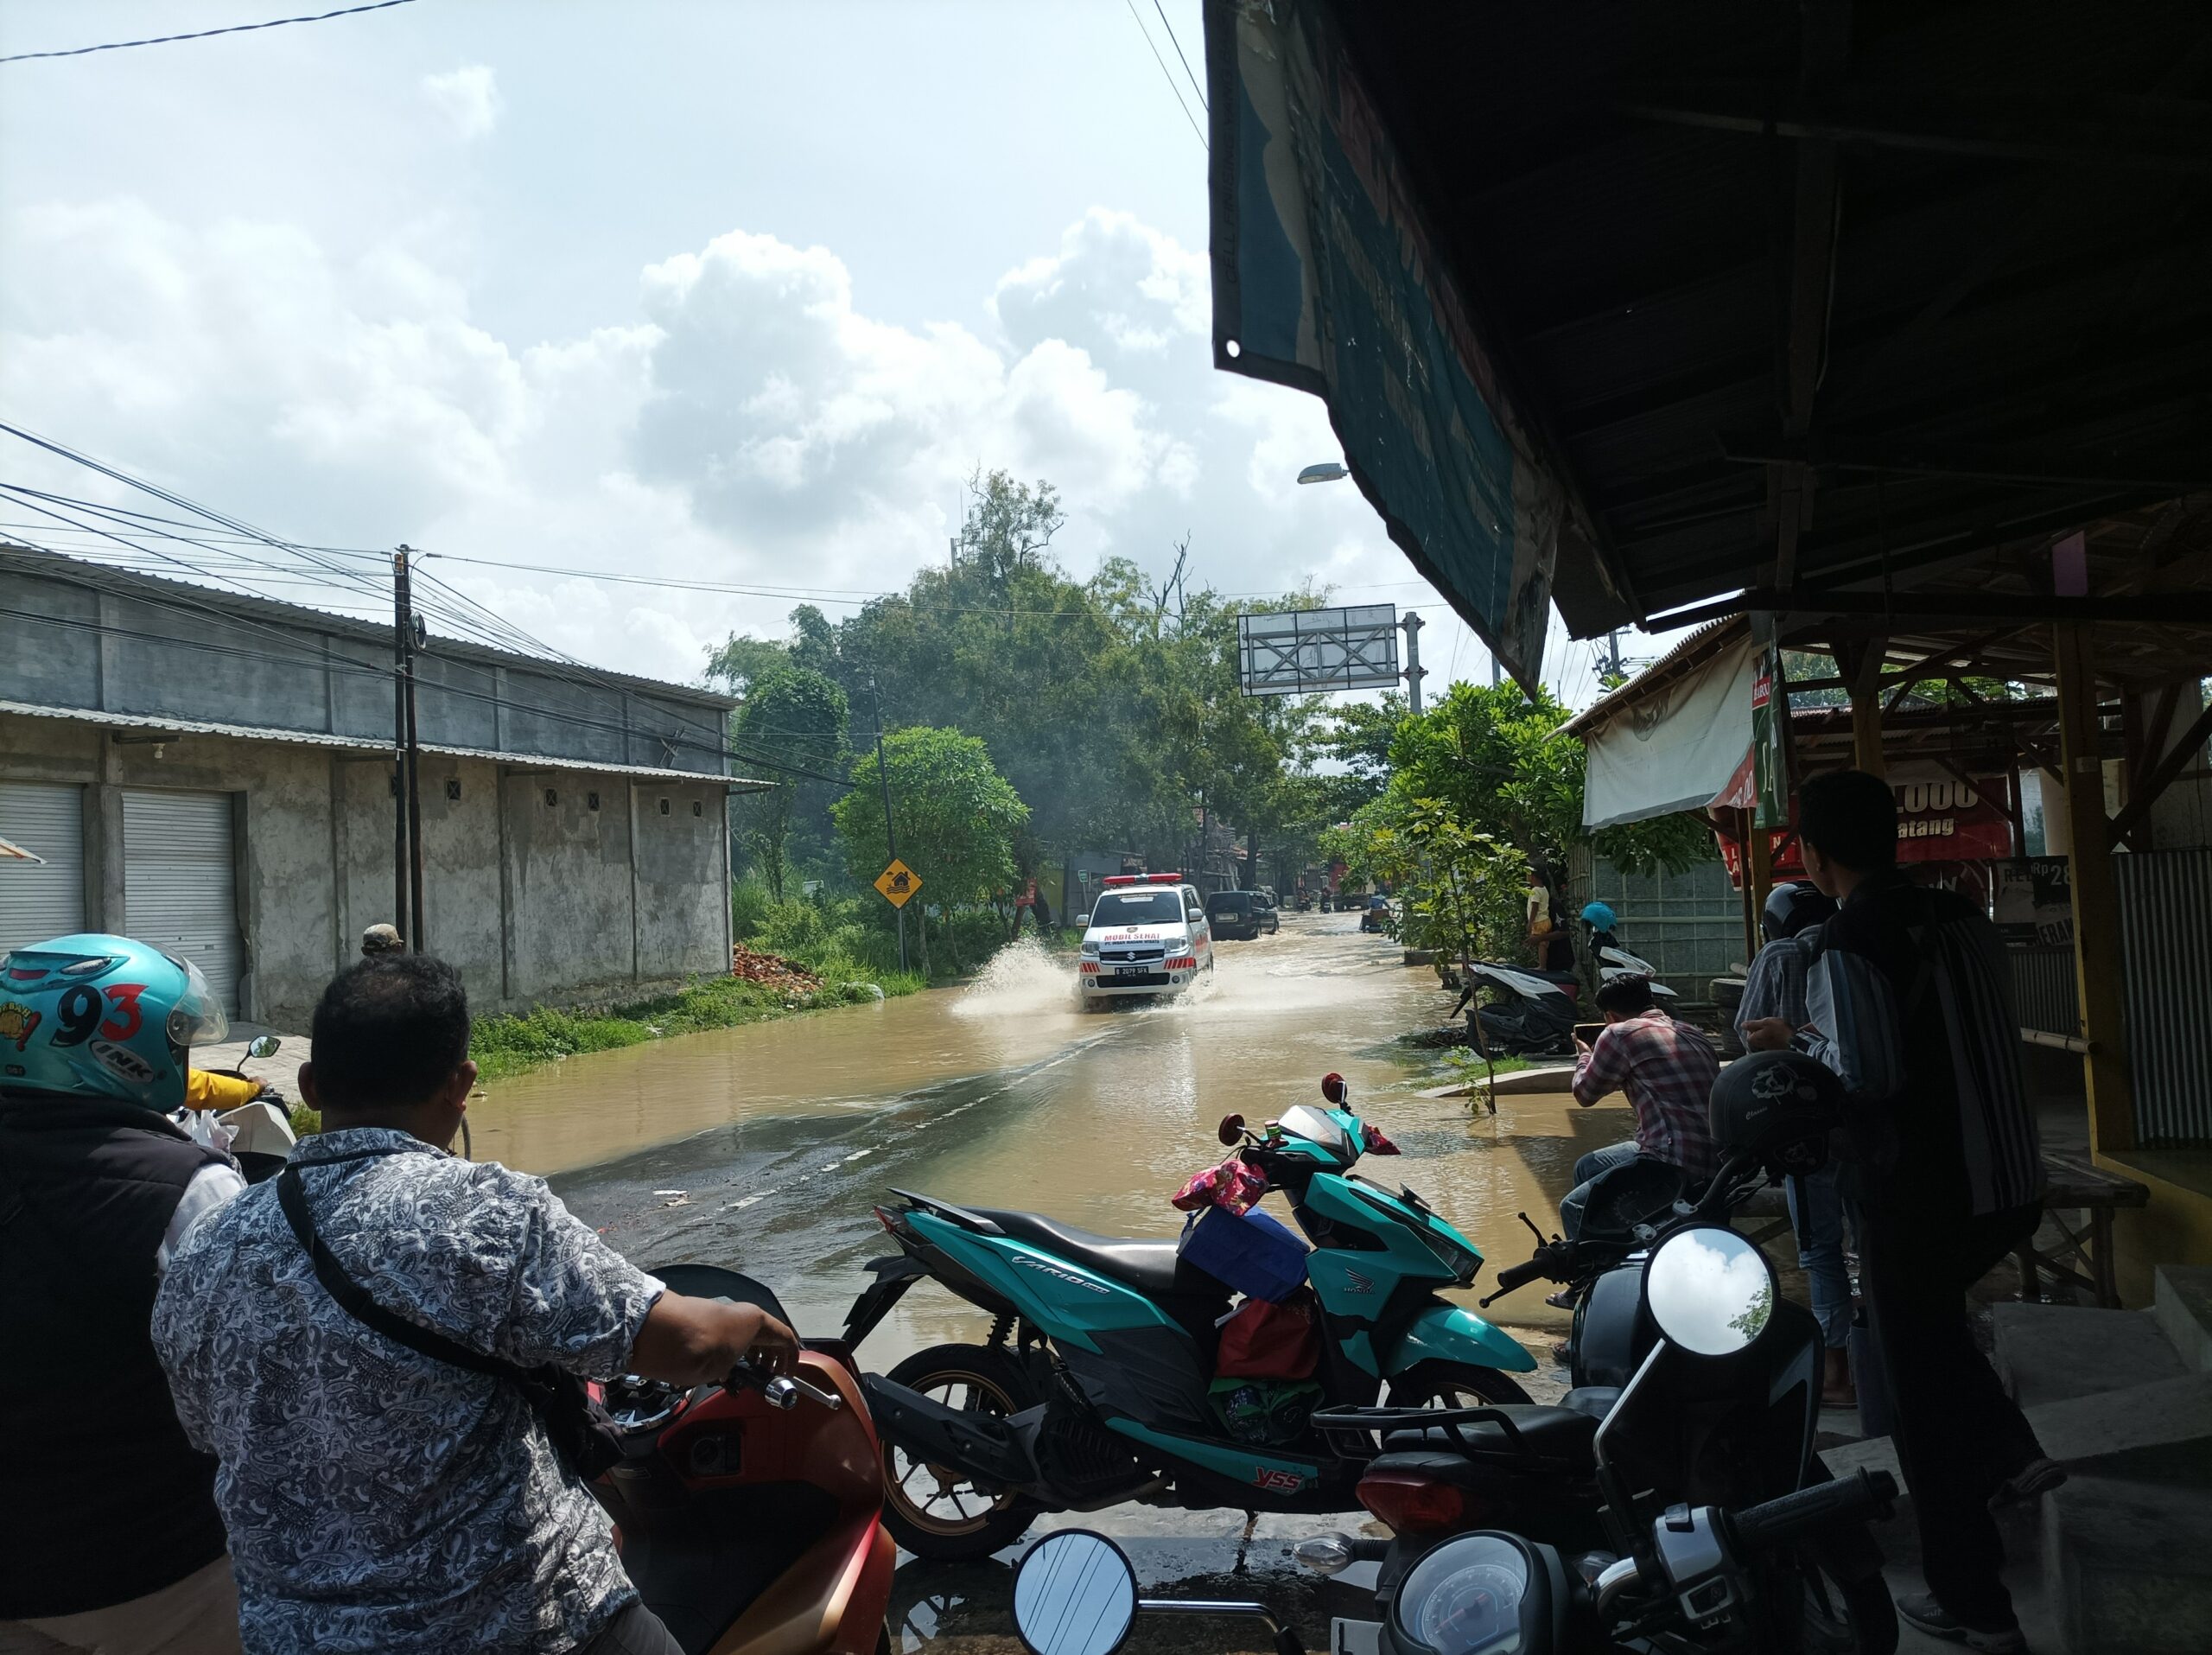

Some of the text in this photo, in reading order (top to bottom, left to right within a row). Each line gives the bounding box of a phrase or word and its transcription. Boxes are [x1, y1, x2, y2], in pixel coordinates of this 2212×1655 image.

[1897, 818, 1955, 838] atang
[49, 983, 149, 1047] 93
[96, 1044, 152, 1079] INK
[1011, 1256, 1085, 1284] VARIO
[1250, 1466, 1303, 1490] YSS
